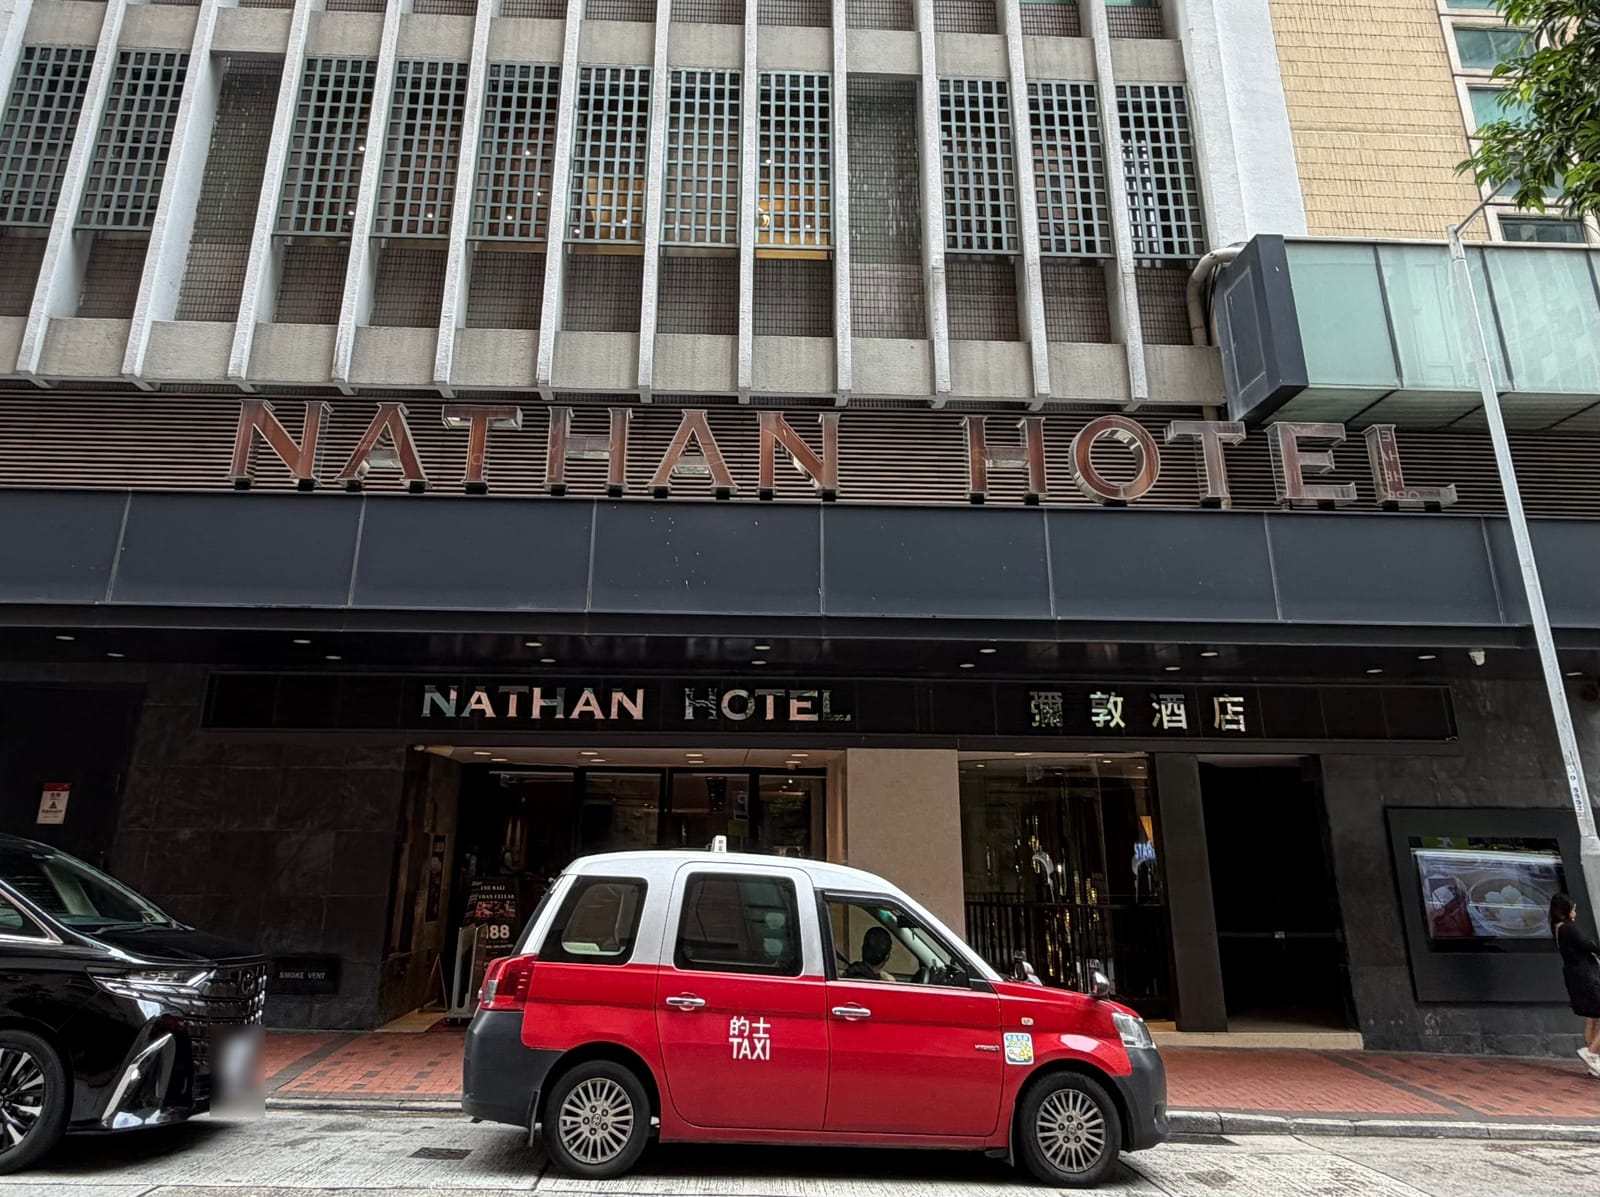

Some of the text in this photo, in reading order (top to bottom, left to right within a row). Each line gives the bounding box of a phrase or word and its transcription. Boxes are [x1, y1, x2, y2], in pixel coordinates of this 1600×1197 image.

[226, 398, 842, 496] NATHAN
[958, 414, 1458, 507] HOTEL
[420, 684, 852, 722] NATHAN HOTEL
[729, 1015, 771, 1038] 的士
[728, 1037, 771, 1061] TAXI
